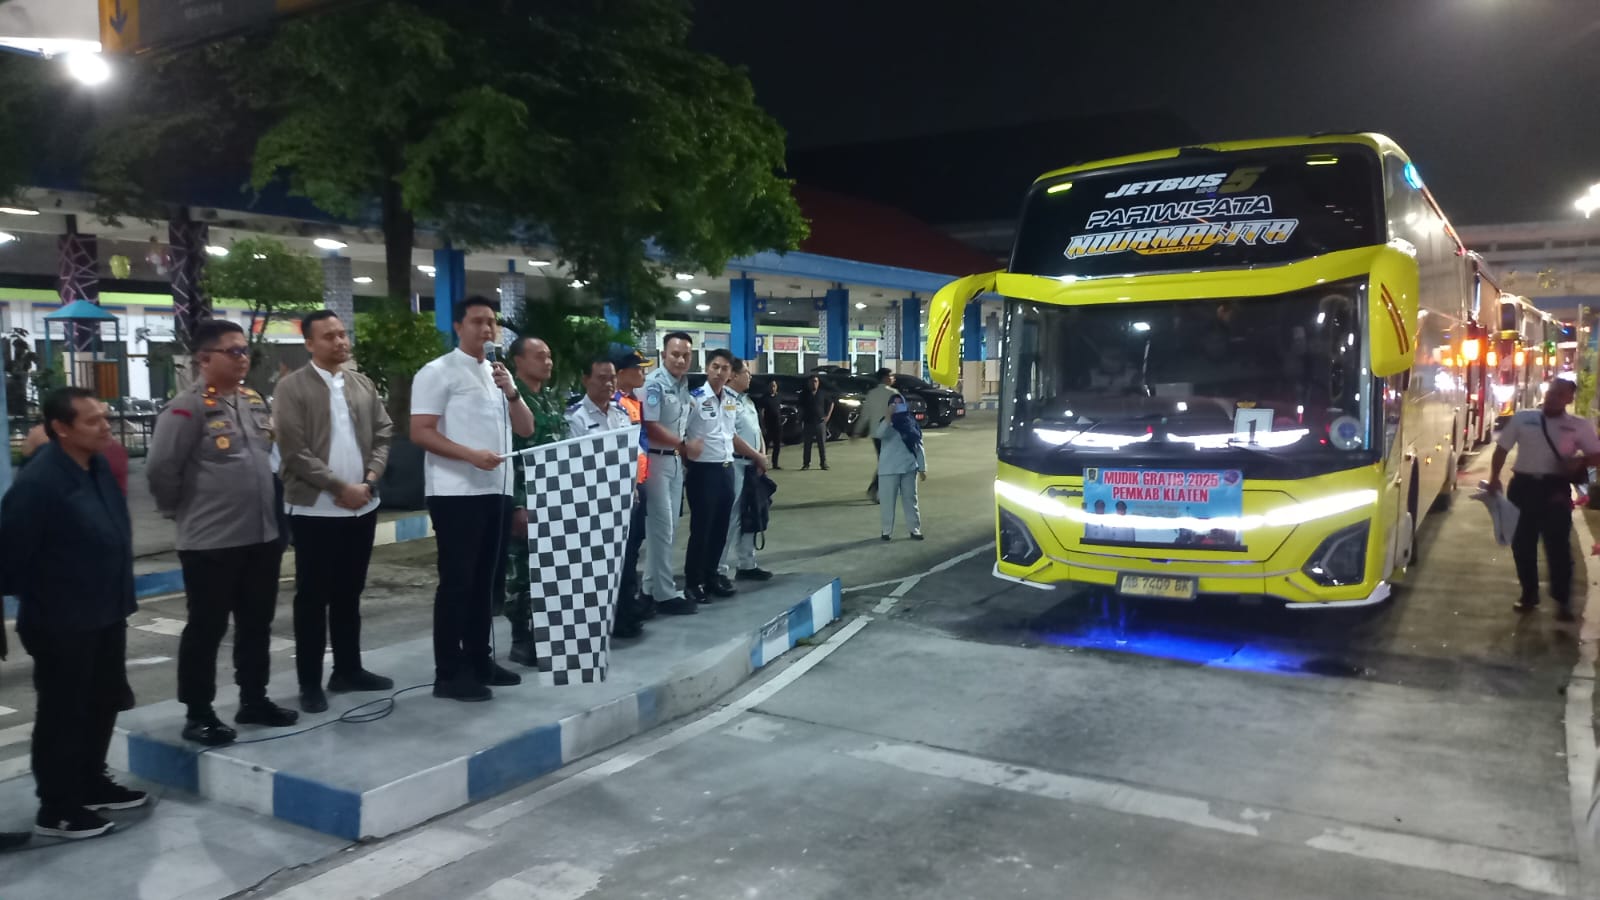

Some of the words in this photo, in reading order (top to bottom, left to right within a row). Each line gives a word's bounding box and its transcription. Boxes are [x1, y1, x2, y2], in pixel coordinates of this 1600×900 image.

[1105, 172, 1228, 199] JETBUS
[1085, 195, 1273, 230] PARIWISATA
[1248, 419, 1257, 444] 1
[1103, 471, 1139, 485] MUDIK
[1143, 472, 1184, 486] GRATIS
[1187, 473, 1220, 487] 2025
[1112, 487, 1160, 501] PEMKAB
[1163, 488, 1209, 503] KLATEN
